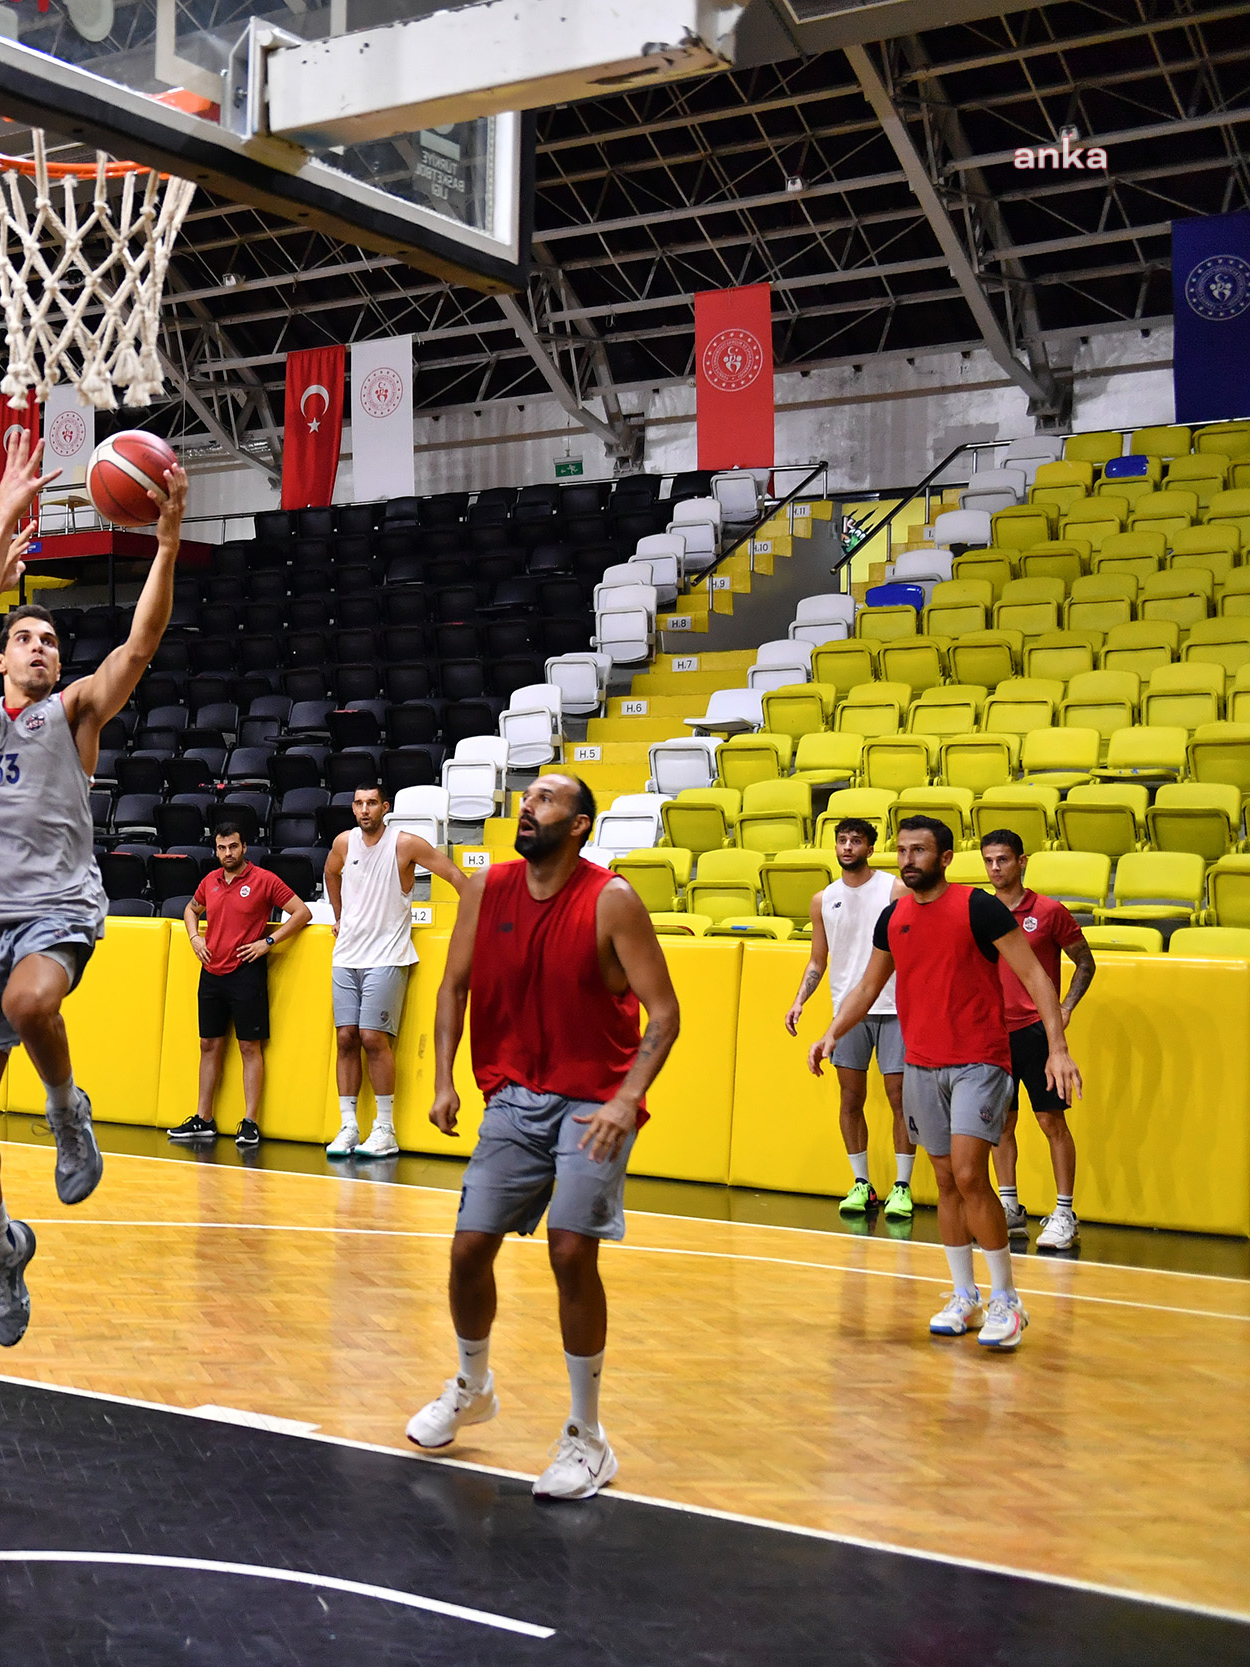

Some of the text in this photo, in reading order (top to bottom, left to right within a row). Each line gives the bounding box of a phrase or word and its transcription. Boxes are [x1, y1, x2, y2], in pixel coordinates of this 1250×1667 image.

[671, 619, 687, 629] H.8
[677, 660, 693, 670] H.7
[626, 704, 642, 713] H.6
[579, 750, 596, 759] H.5
[468, 856, 485, 865] H.3
[411, 911, 427, 921] H.2
